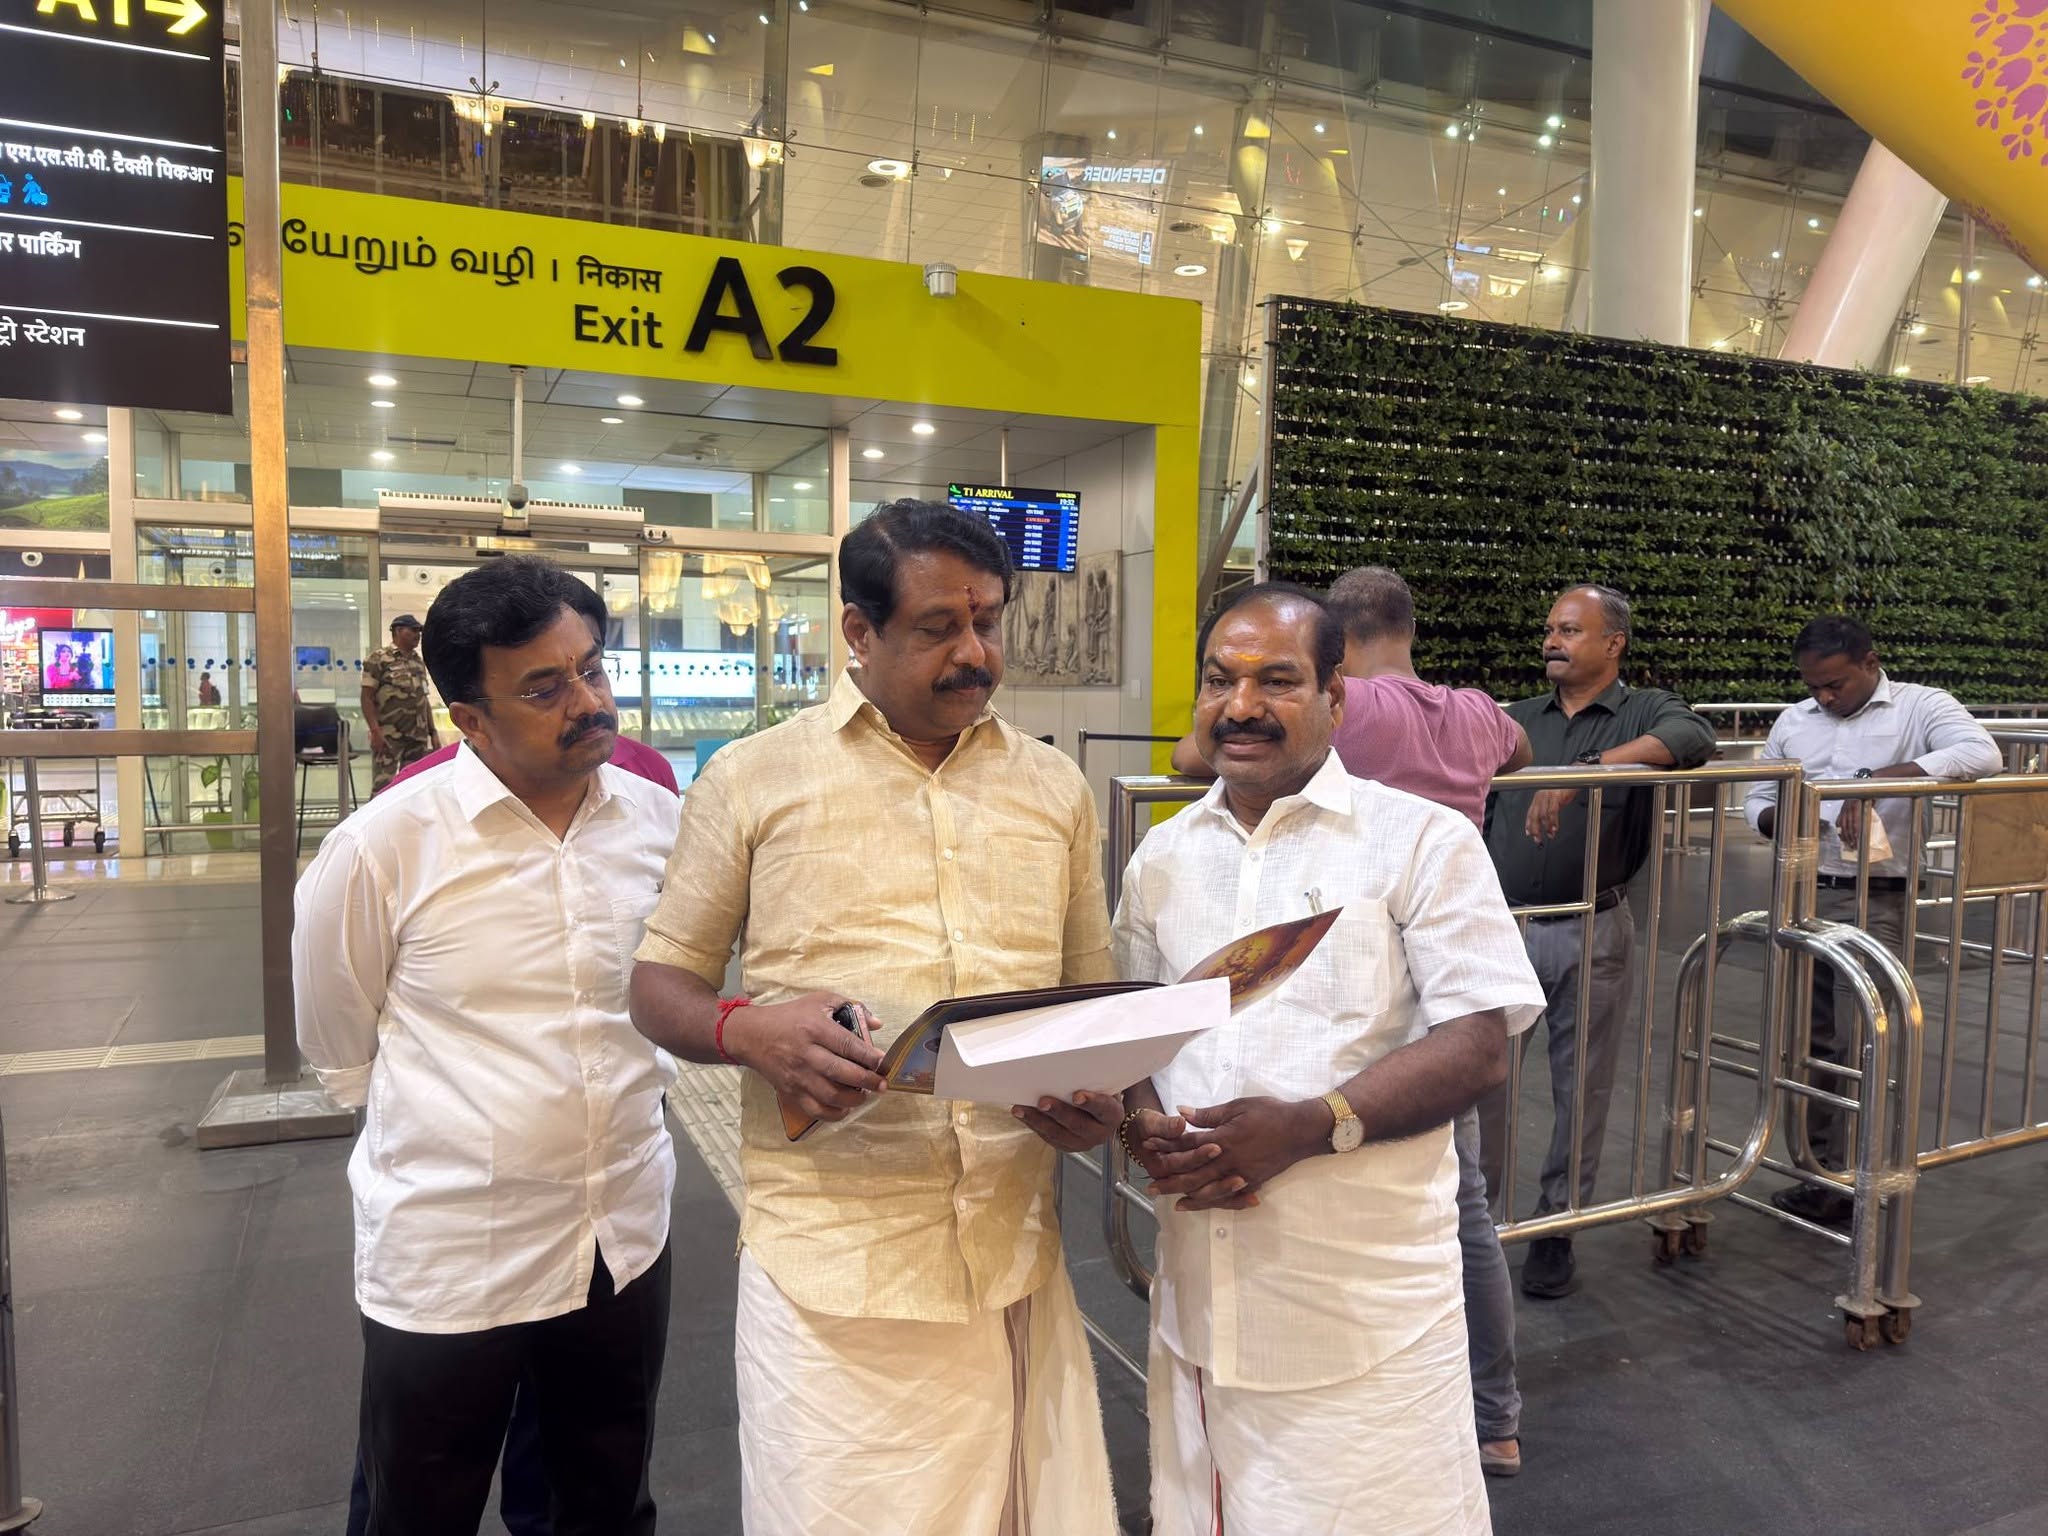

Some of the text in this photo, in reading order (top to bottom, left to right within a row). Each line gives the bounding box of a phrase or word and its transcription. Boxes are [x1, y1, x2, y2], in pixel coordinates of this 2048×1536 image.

[112, 150, 154, 177] टैक्सी
[155, 157, 214, 183] पिकअप
[17, 231, 81, 258] पार्किंग
[451, 246, 534, 286] வழி
[576, 254, 662, 293] निकास
[574, 256, 838, 366] Exit A2
[22, 318, 86, 346] स्टेशन
[975, 489, 1014, 499] ARRIVAL
